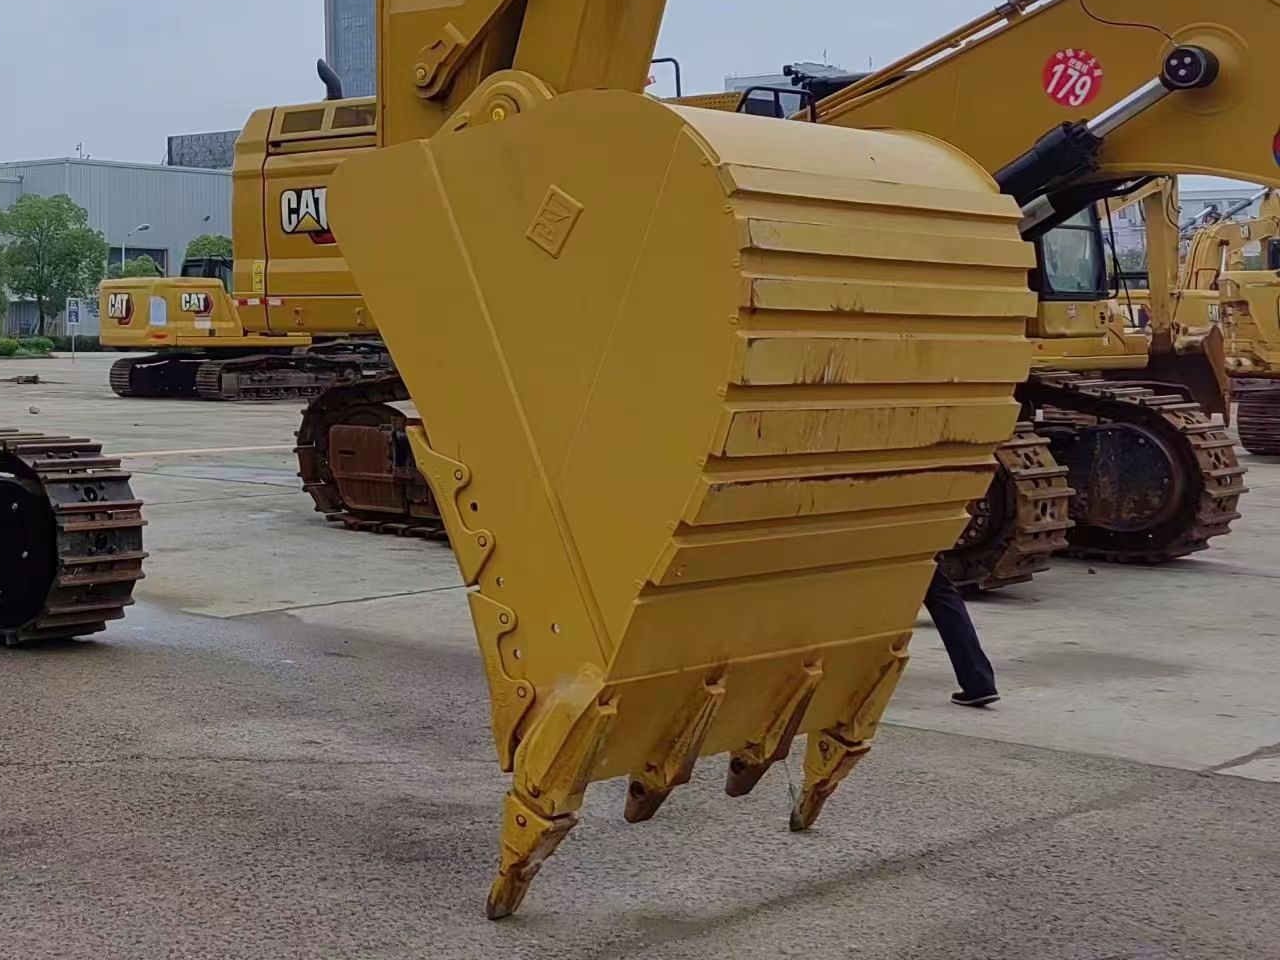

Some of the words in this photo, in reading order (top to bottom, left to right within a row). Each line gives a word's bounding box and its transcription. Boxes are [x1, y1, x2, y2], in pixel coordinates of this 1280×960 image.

[1046, 63, 1091, 106] 179
[281, 188, 328, 233] CAT
[108, 293, 129, 318] CAT
[181, 293, 206, 311] CAT
[1208, 303, 1220, 321] CAT
